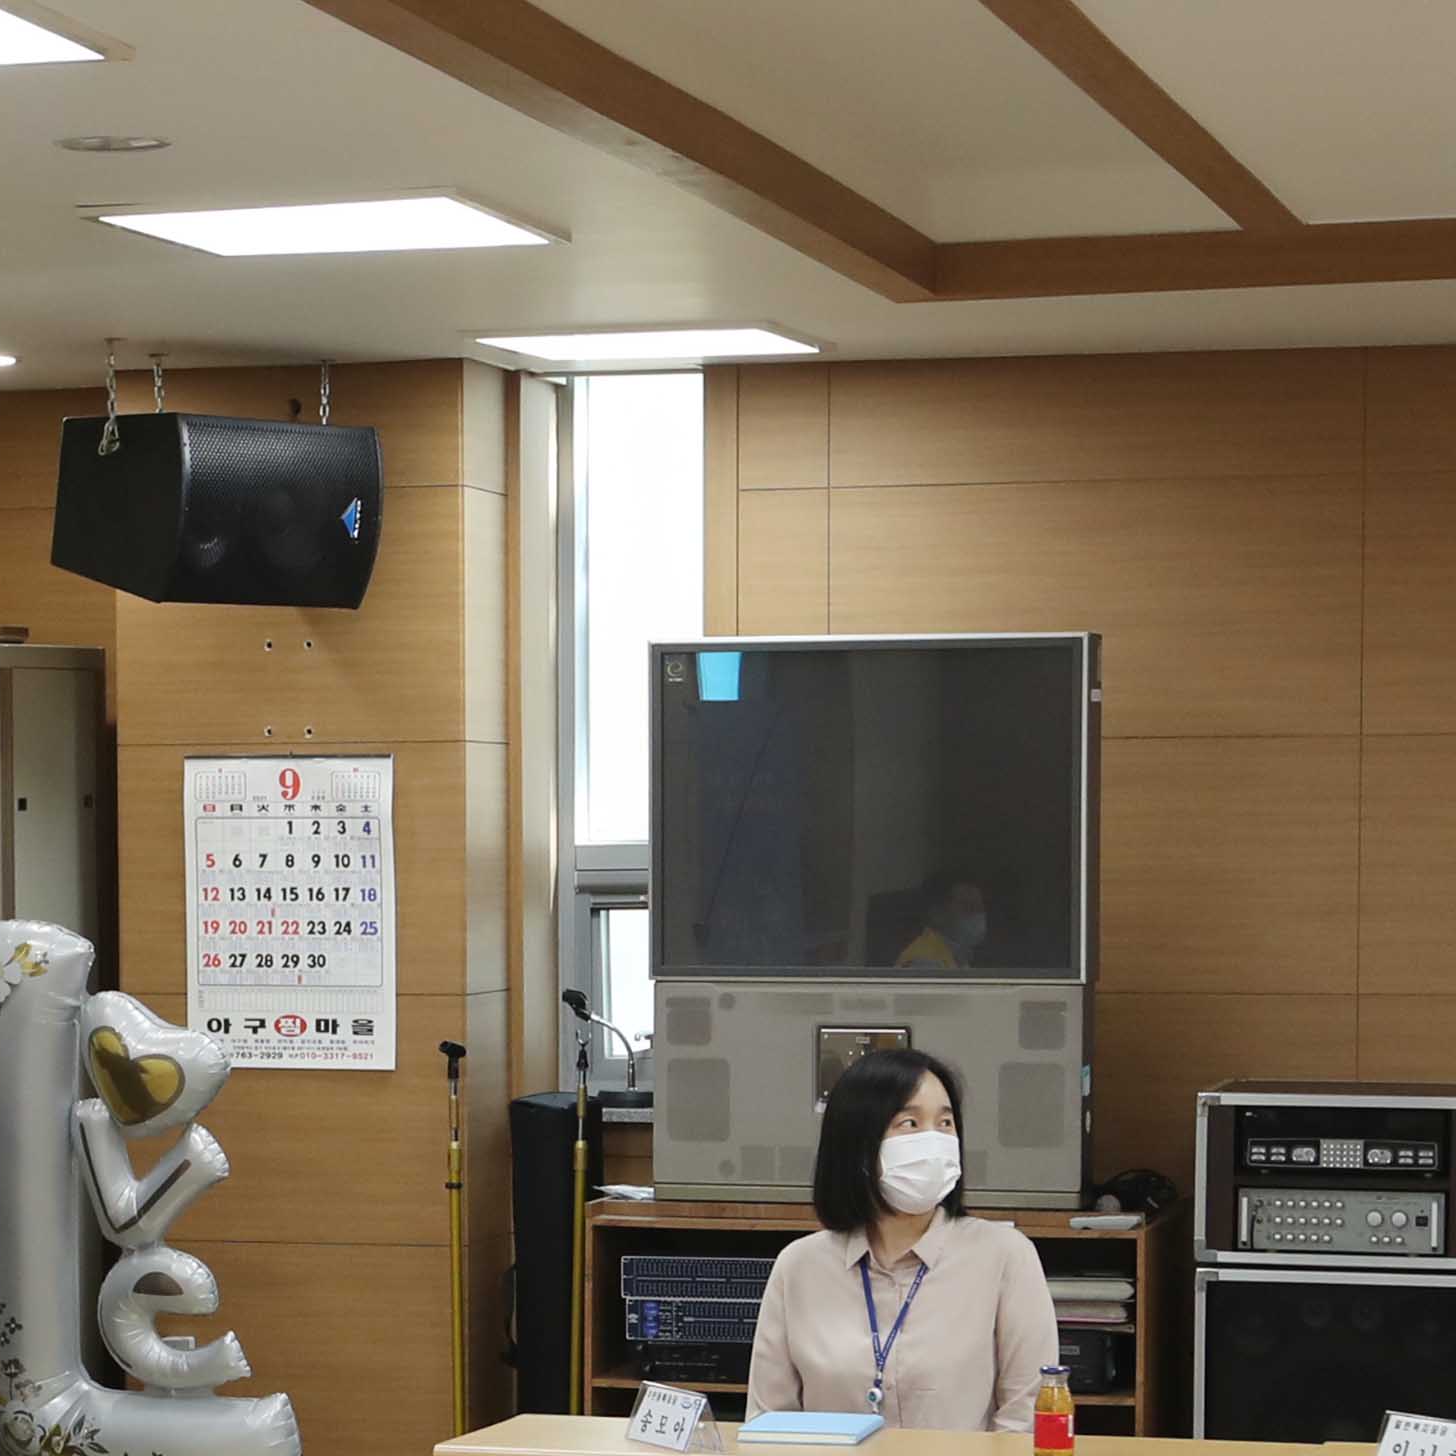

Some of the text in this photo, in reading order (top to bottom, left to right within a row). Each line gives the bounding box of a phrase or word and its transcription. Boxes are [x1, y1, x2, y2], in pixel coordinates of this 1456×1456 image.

[279, 767, 302, 801] 9
[257, 803, 270, 812] 火
[287, 821, 371, 835] 1 2 3 4
[206, 854, 376, 868] 5 6 7 8 9 10 11
[202, 887, 377, 901] 12 13 14 15 16 17 18
[203, 921, 378, 935] 19 20 21 22 23 24 25
[202, 954, 326, 968] 26 27 28 29 30
